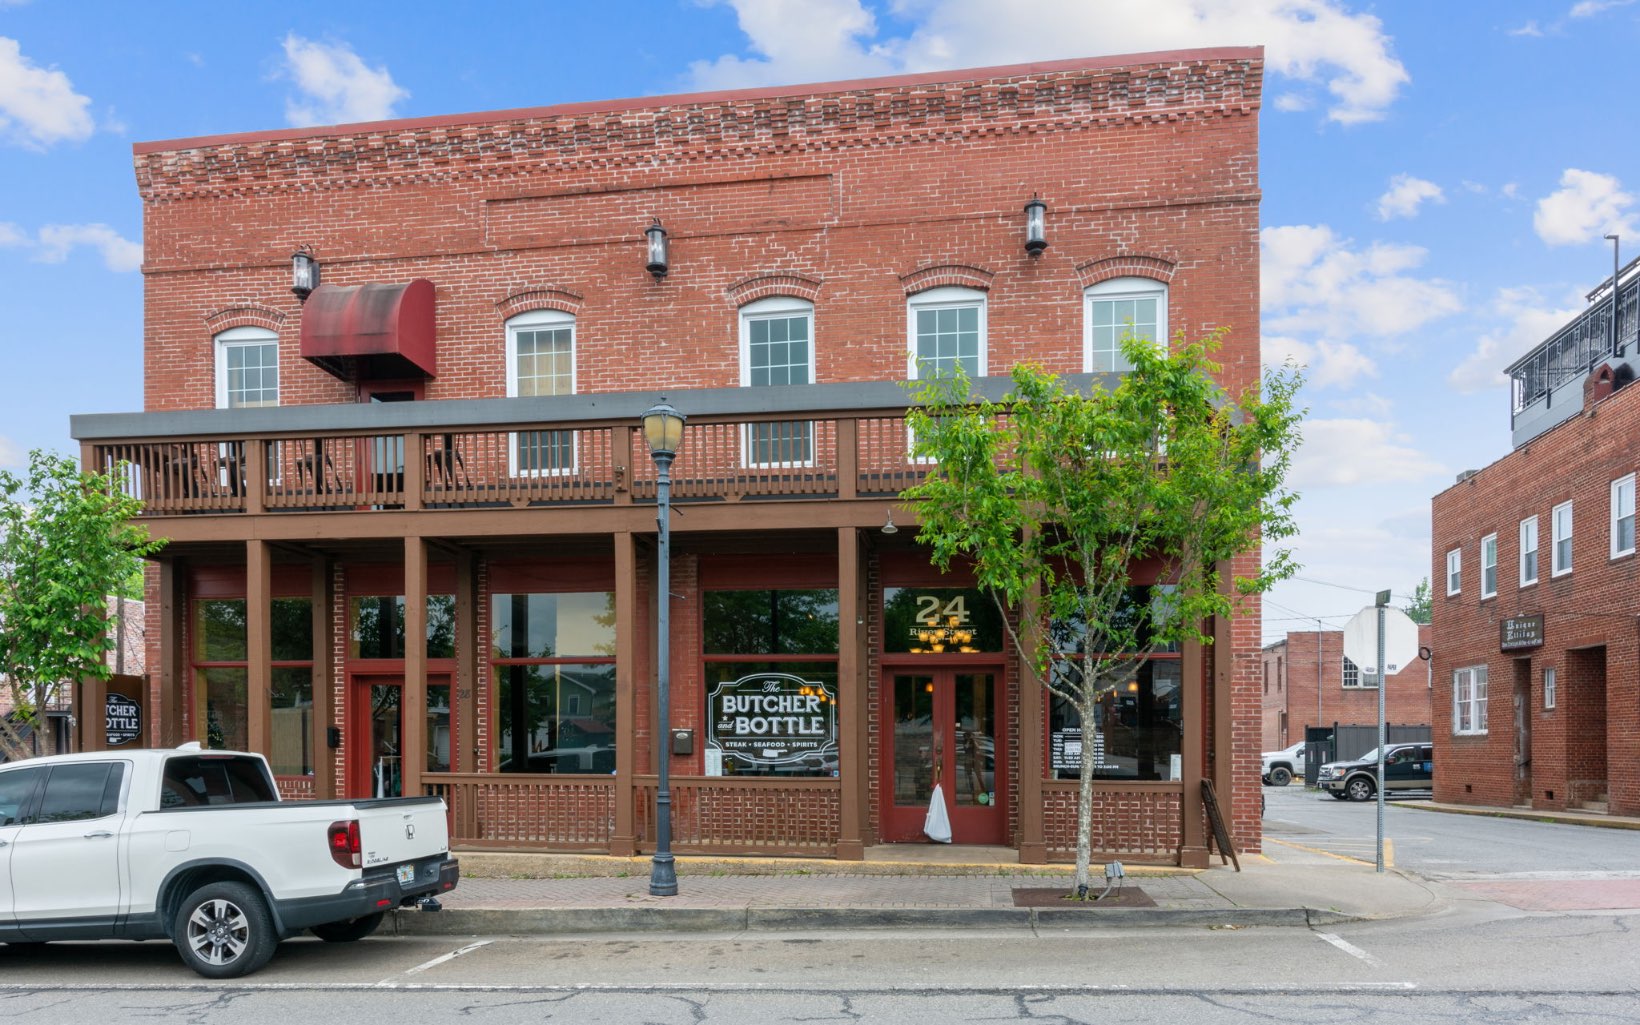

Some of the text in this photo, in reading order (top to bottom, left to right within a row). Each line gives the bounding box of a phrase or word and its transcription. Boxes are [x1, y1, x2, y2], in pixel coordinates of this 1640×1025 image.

[916, 595, 970, 622] 24
[943, 628, 977, 636] Street
[762, 681, 780, 692] The
[722, 695, 821, 713] BUTCHER
[718, 716, 825, 734] and BOTTLE
